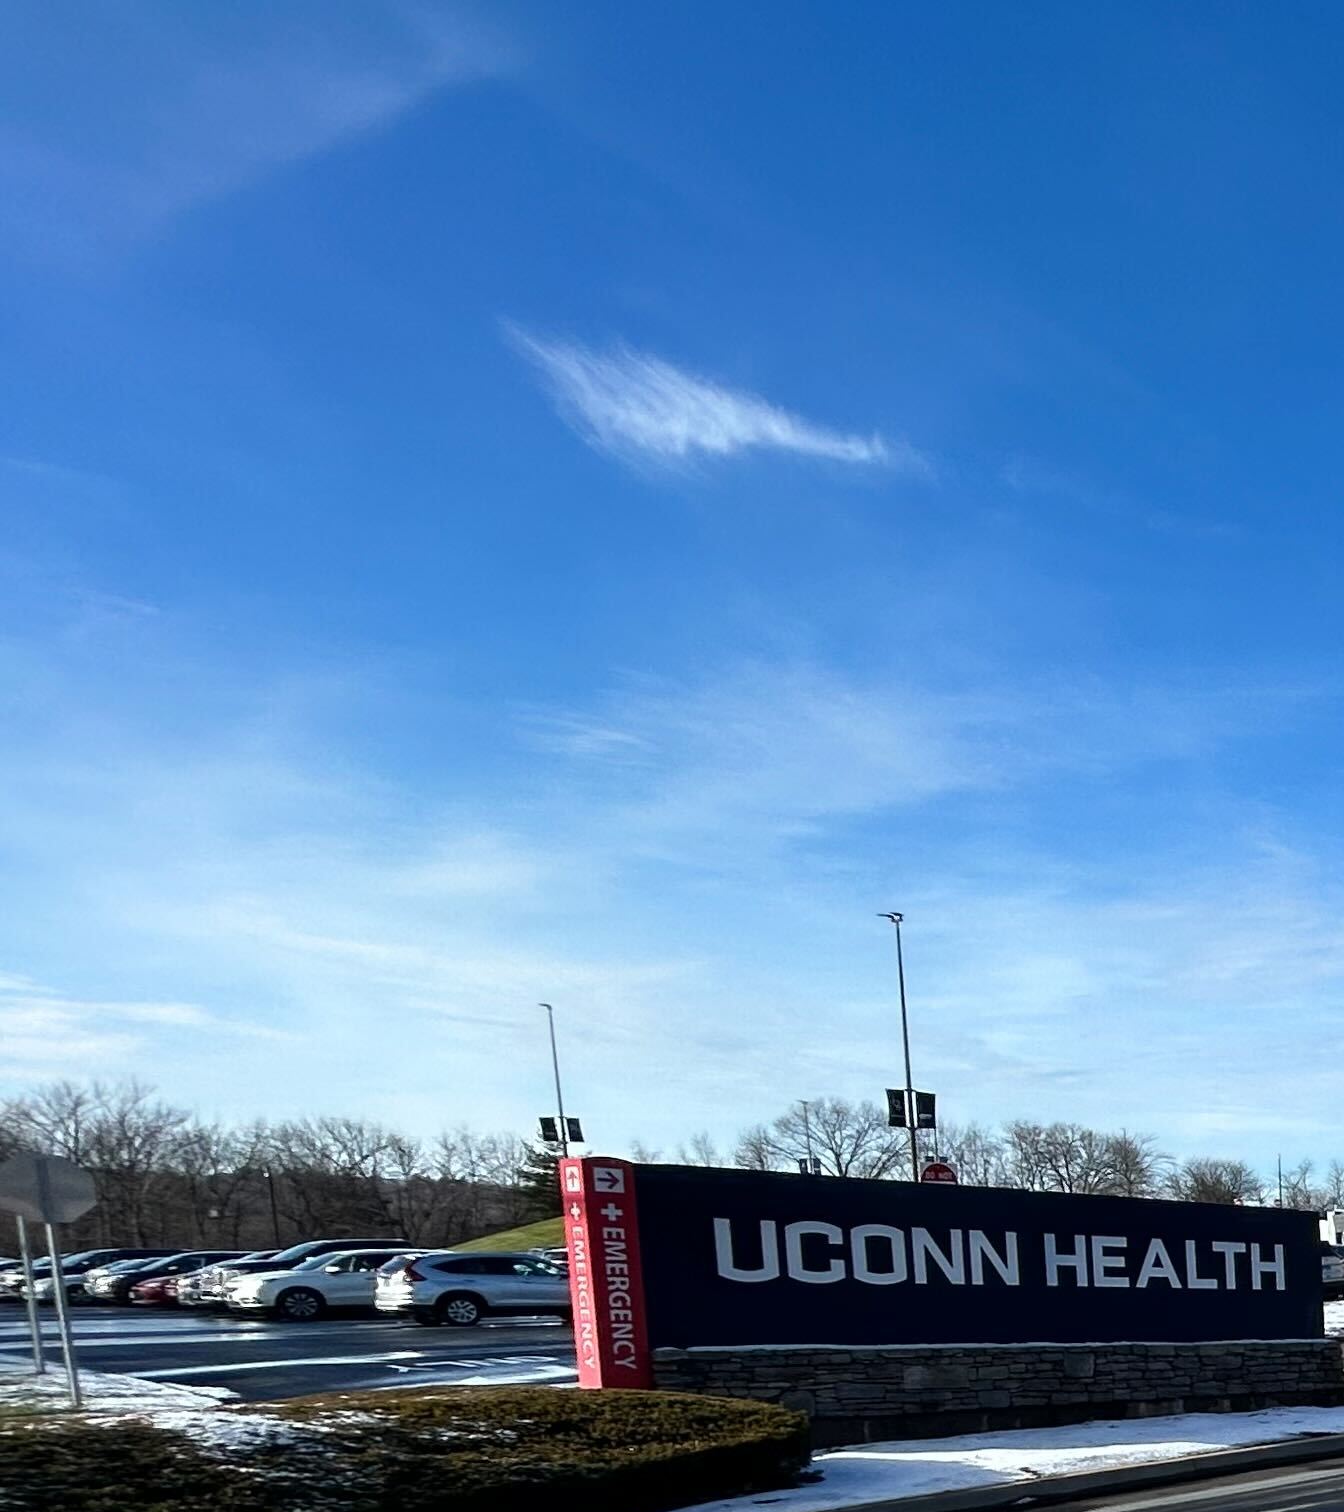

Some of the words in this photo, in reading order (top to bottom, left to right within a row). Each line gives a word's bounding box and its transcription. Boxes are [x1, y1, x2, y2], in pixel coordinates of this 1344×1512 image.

[571, 1226, 595, 1369] EMERGENCY
[603, 1227, 636, 1369] EMERGENCY
[713, 1217, 1019, 1286] UCONN
[1043, 1233, 1286, 1291] HEALTH
